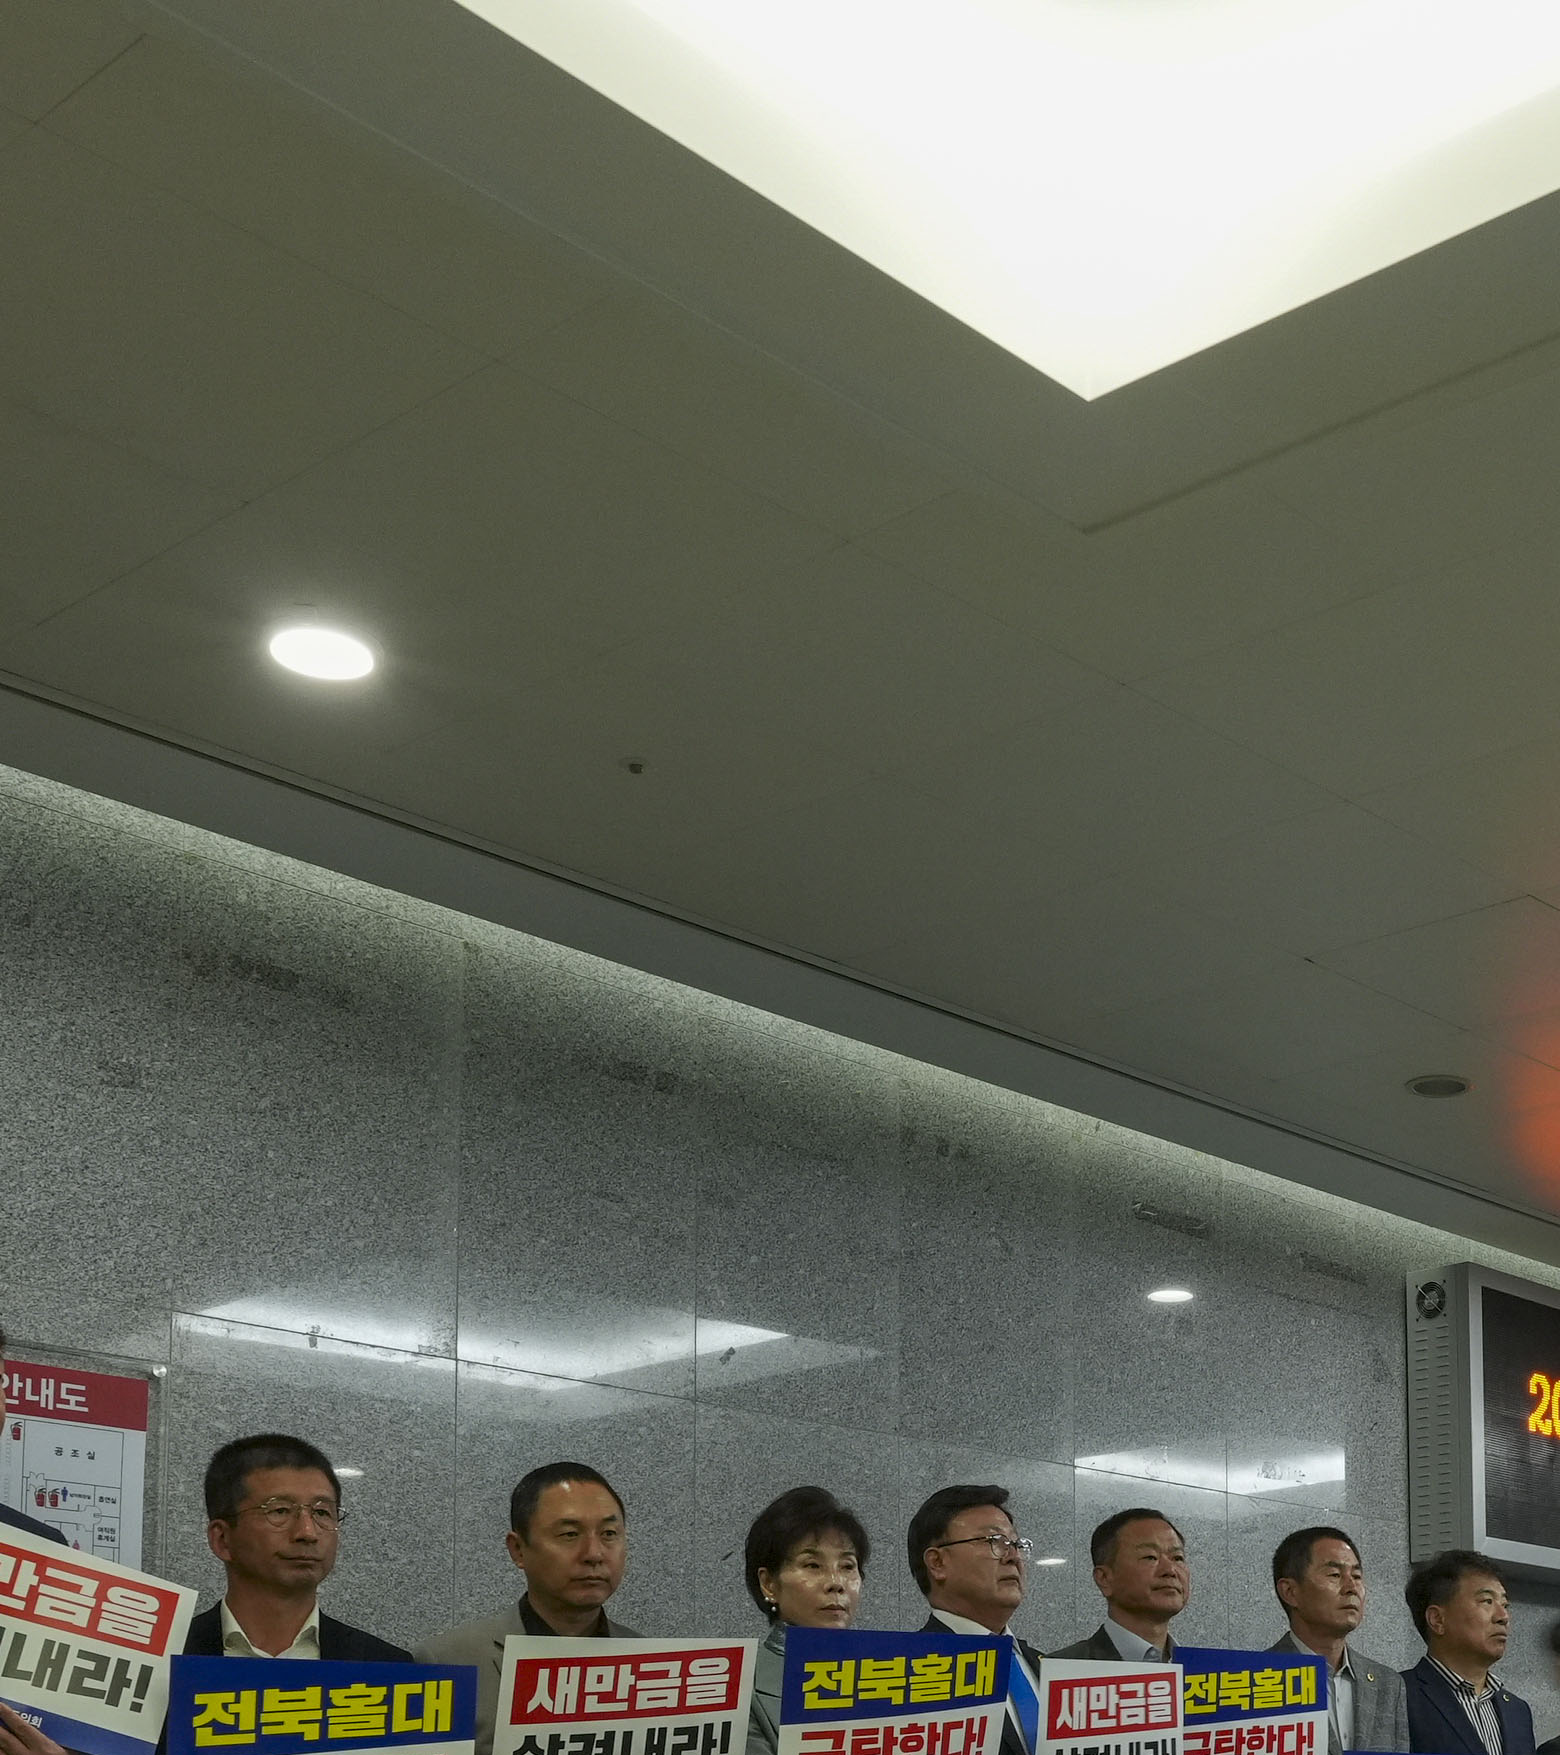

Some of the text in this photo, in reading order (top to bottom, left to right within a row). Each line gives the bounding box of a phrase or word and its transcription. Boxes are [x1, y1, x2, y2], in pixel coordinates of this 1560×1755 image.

[54, 1446, 96, 1460] 공조실
[527, 1657, 730, 1715] 새만금을
[802, 1649, 996, 1710] 전북홀대
[1056, 1679, 1172, 1732] 새만금을
[1183, 1665, 1316, 1715] 전북홀대
[192, 1679, 453, 1747] 전북홀대
